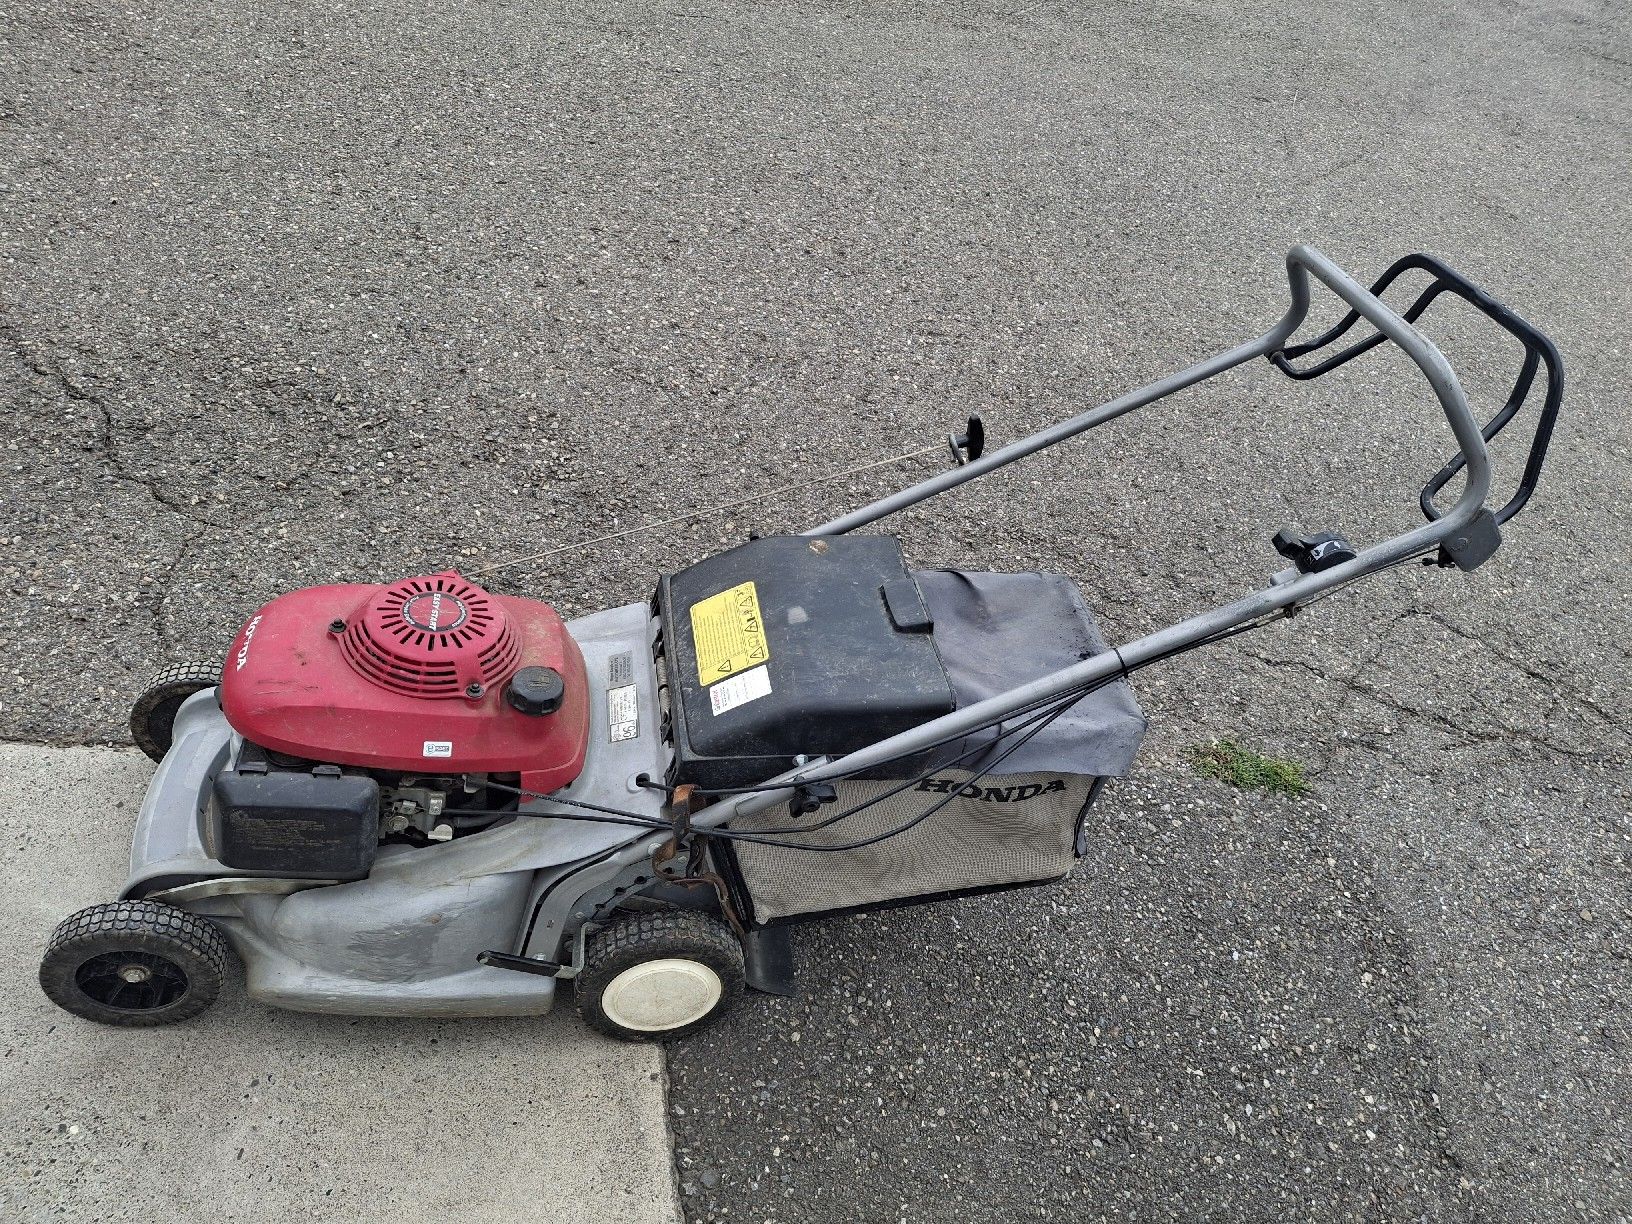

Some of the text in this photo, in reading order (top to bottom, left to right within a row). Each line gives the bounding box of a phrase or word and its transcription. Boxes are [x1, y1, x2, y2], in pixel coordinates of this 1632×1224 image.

[429, 593, 441, 631] EASY START
[914, 779, 1067, 803] HONDA
